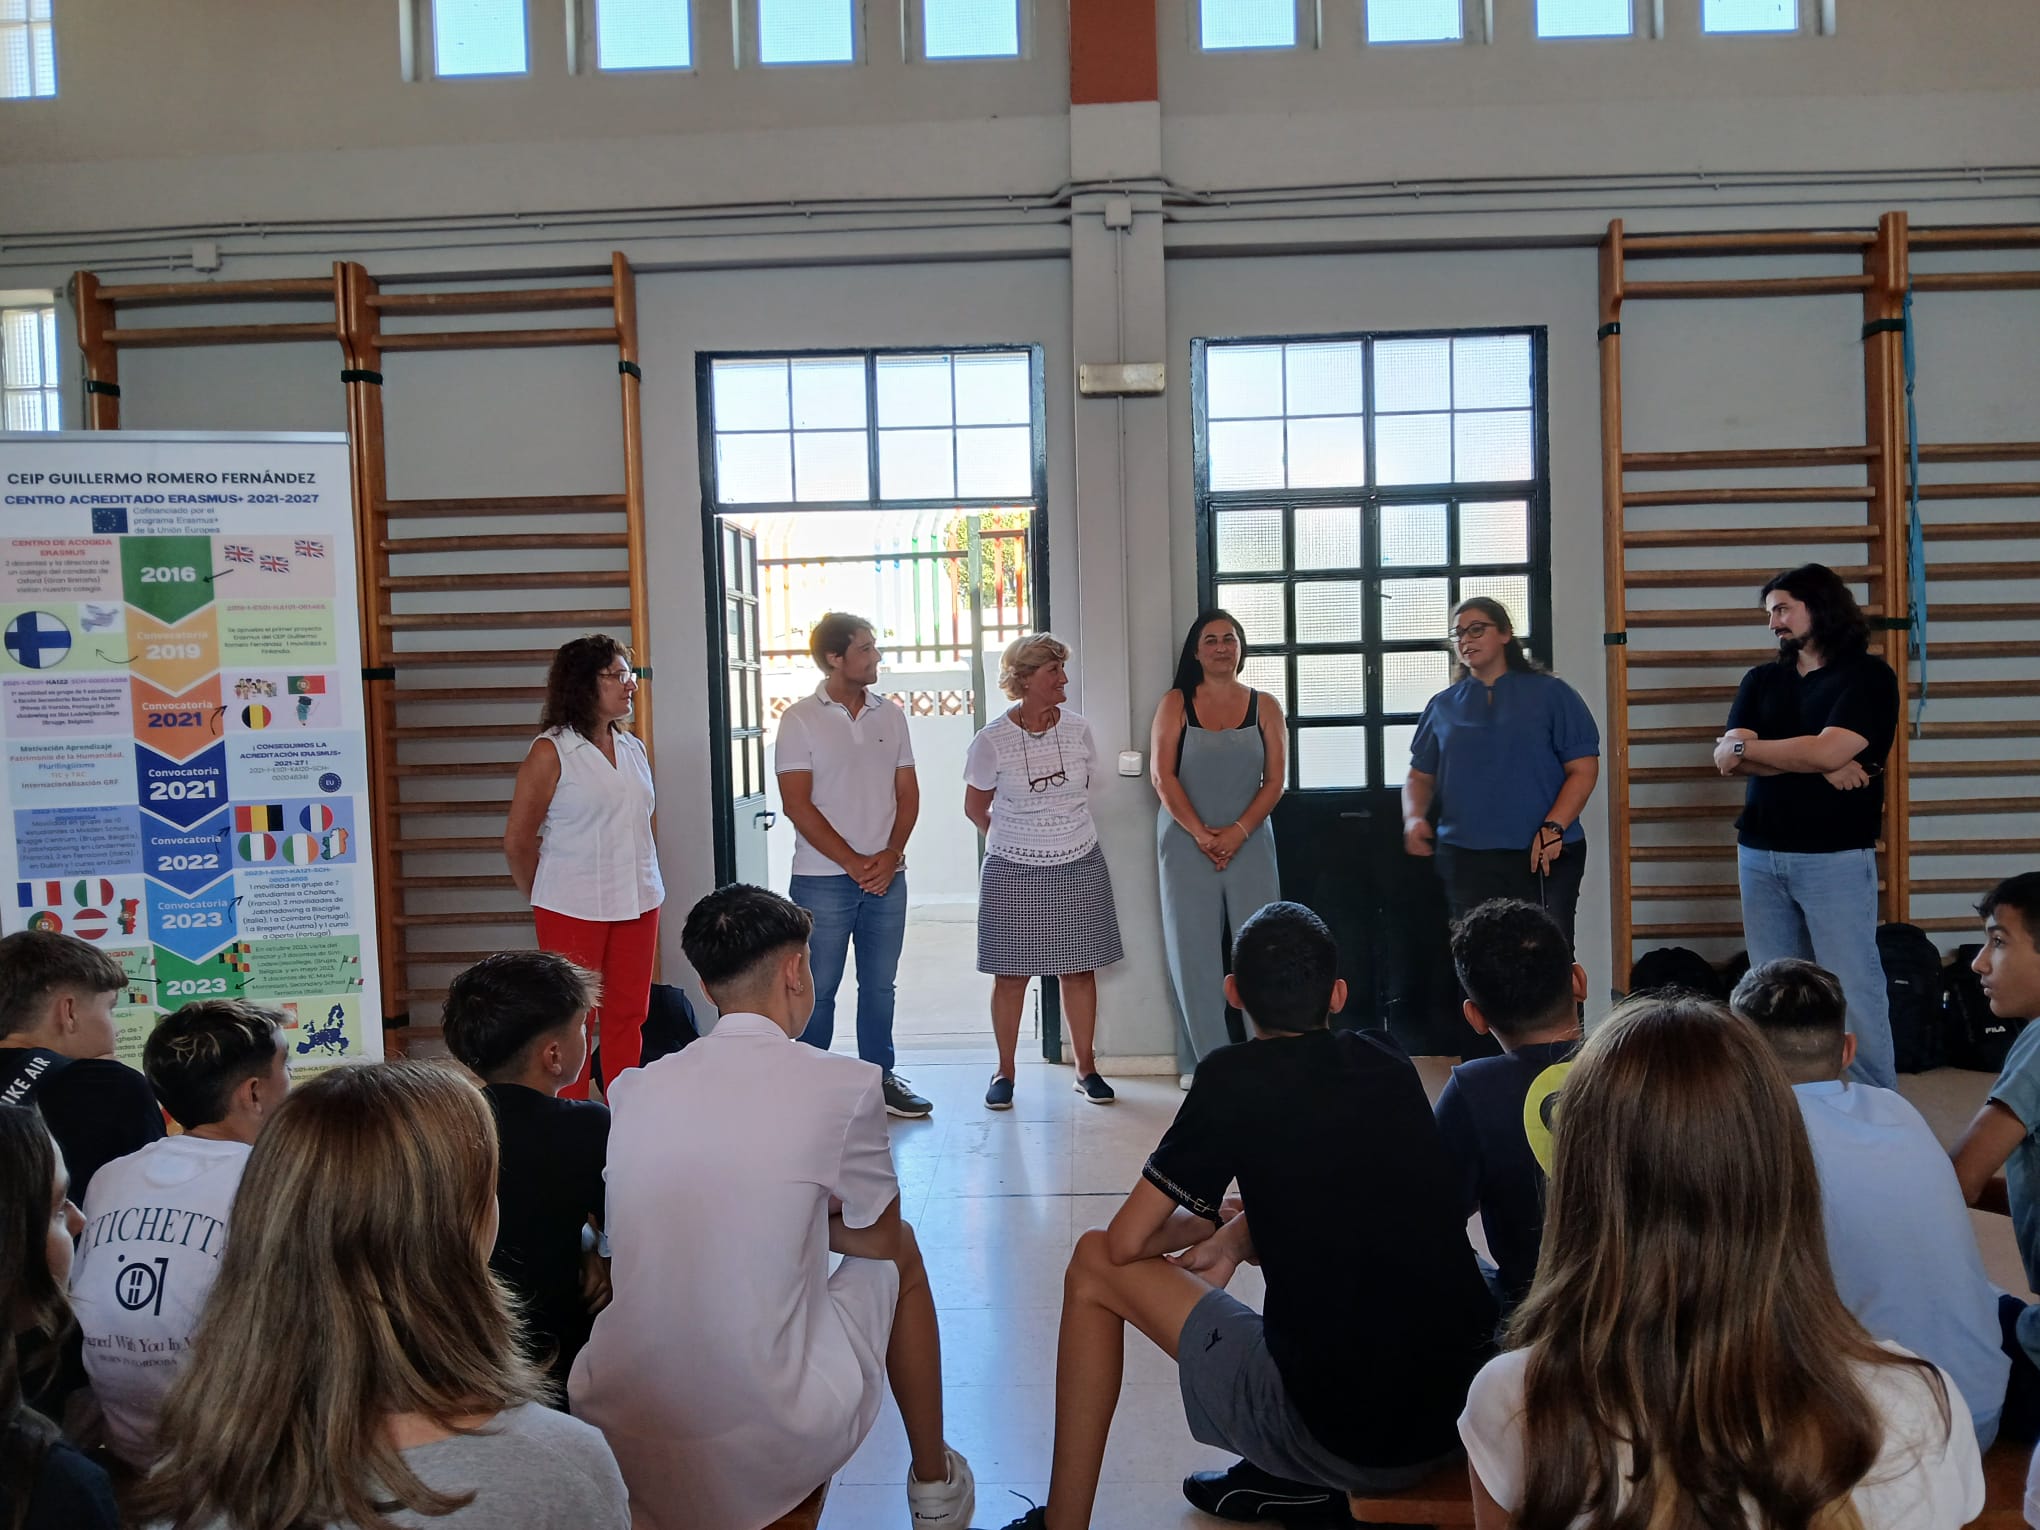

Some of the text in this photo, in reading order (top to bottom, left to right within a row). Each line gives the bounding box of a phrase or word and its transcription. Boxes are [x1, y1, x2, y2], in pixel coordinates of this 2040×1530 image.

[7, 470, 316, 484] CEIP GUILLERMO ROMERO FERNÁNDEZ
[4, 494, 320, 504] CENTRO ACREDITADO ERASMUS+ 2021-2027
[140, 567, 196, 582] 2016
[136, 632, 208, 640] Convocatoria
[146, 644, 201, 659] 2019
[142, 701, 213, 710] Convocatoria
[148, 712, 202, 728] 2021
[240, 751, 299, 759] ACREDITACIÓN
[148, 767, 220, 777] Convocatoria
[150, 780, 216, 800] 2021
[151, 835, 222, 845] Convocatoria
[158, 854, 219, 871] 2022
[158, 900, 228, 910] Convocatoria
[162, 912, 223, 929] 2023
[166, 978, 227, 996] 2023
[1985, 1026, 2006, 1034] FILA
[0, 1057, 51, 1104] IKE AIR
[139, 1338, 164, 1353] You
